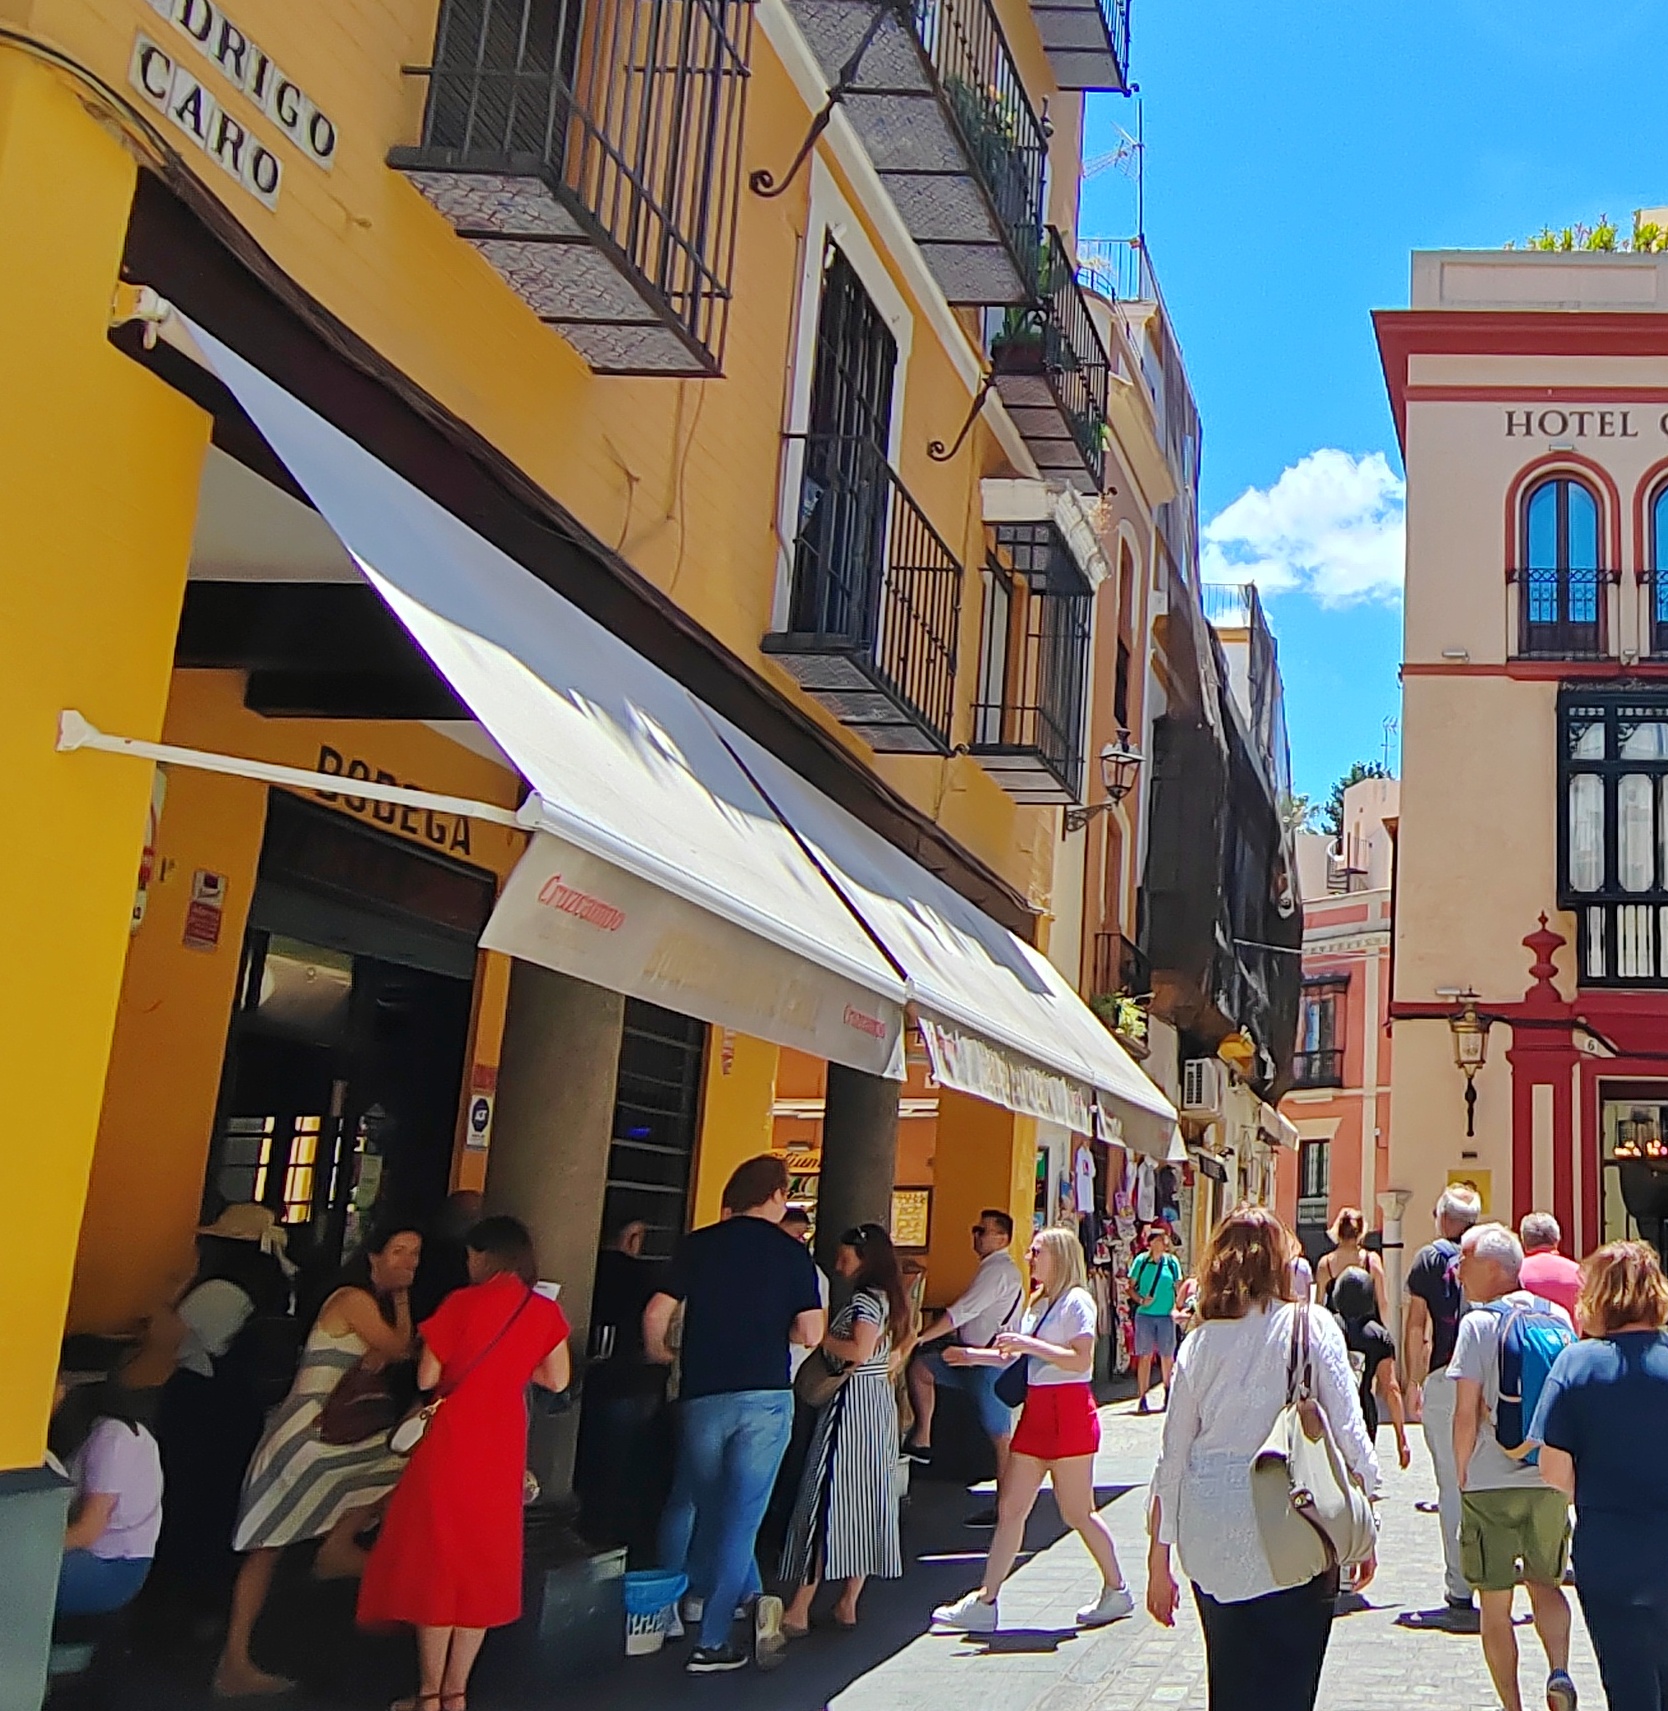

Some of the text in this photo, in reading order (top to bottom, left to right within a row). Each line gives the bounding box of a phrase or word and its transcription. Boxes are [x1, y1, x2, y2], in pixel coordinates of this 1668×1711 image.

[140, 45, 280, 194] CARO
[1505, 409, 1639, 438] HOTEL
[316, 744, 471, 856] BODEGA
